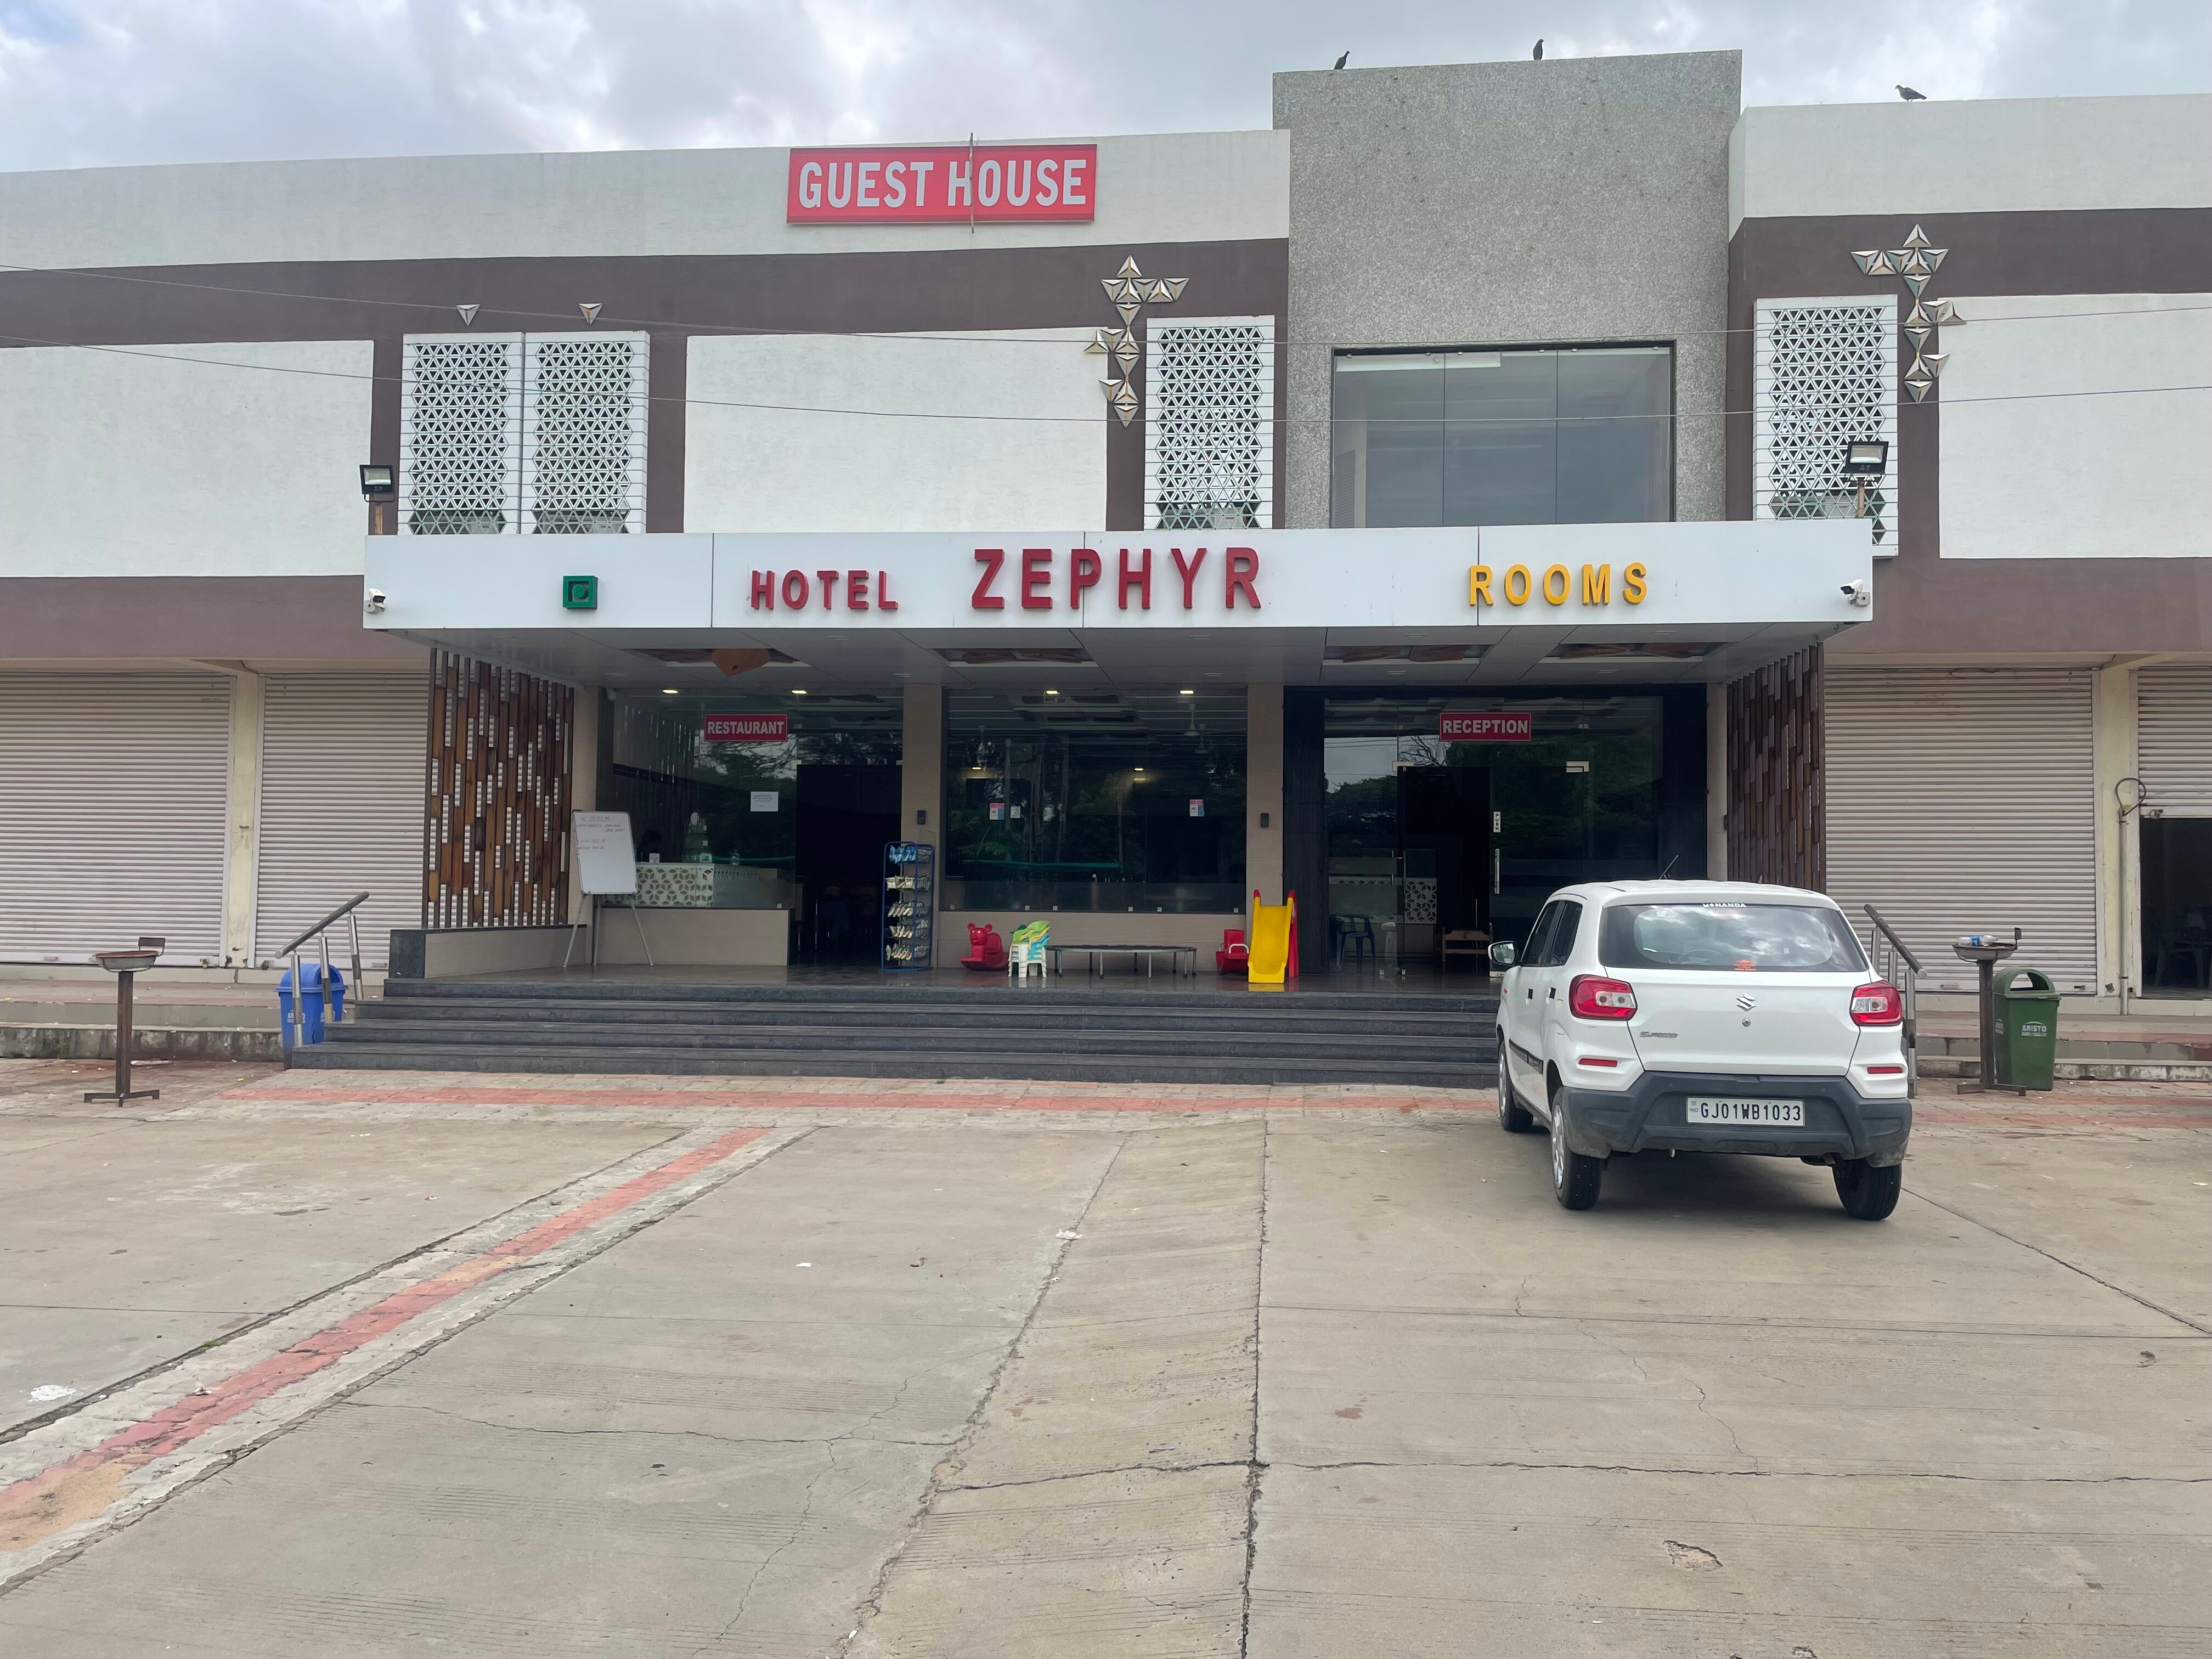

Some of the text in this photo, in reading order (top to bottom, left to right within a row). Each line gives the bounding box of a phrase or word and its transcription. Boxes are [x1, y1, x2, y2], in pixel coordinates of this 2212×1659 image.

[799, 159, 1087, 208] GUEST HOUSE
[751, 547, 1261, 610] HOTEL ZEPHYR
[1469, 562, 1647, 606] ROOMS
[707, 721, 785, 734] RESTAURANT
[1442, 720, 1528, 733] RECEPTION
[1701, 1102, 1801, 1121] GJ01WB1033
